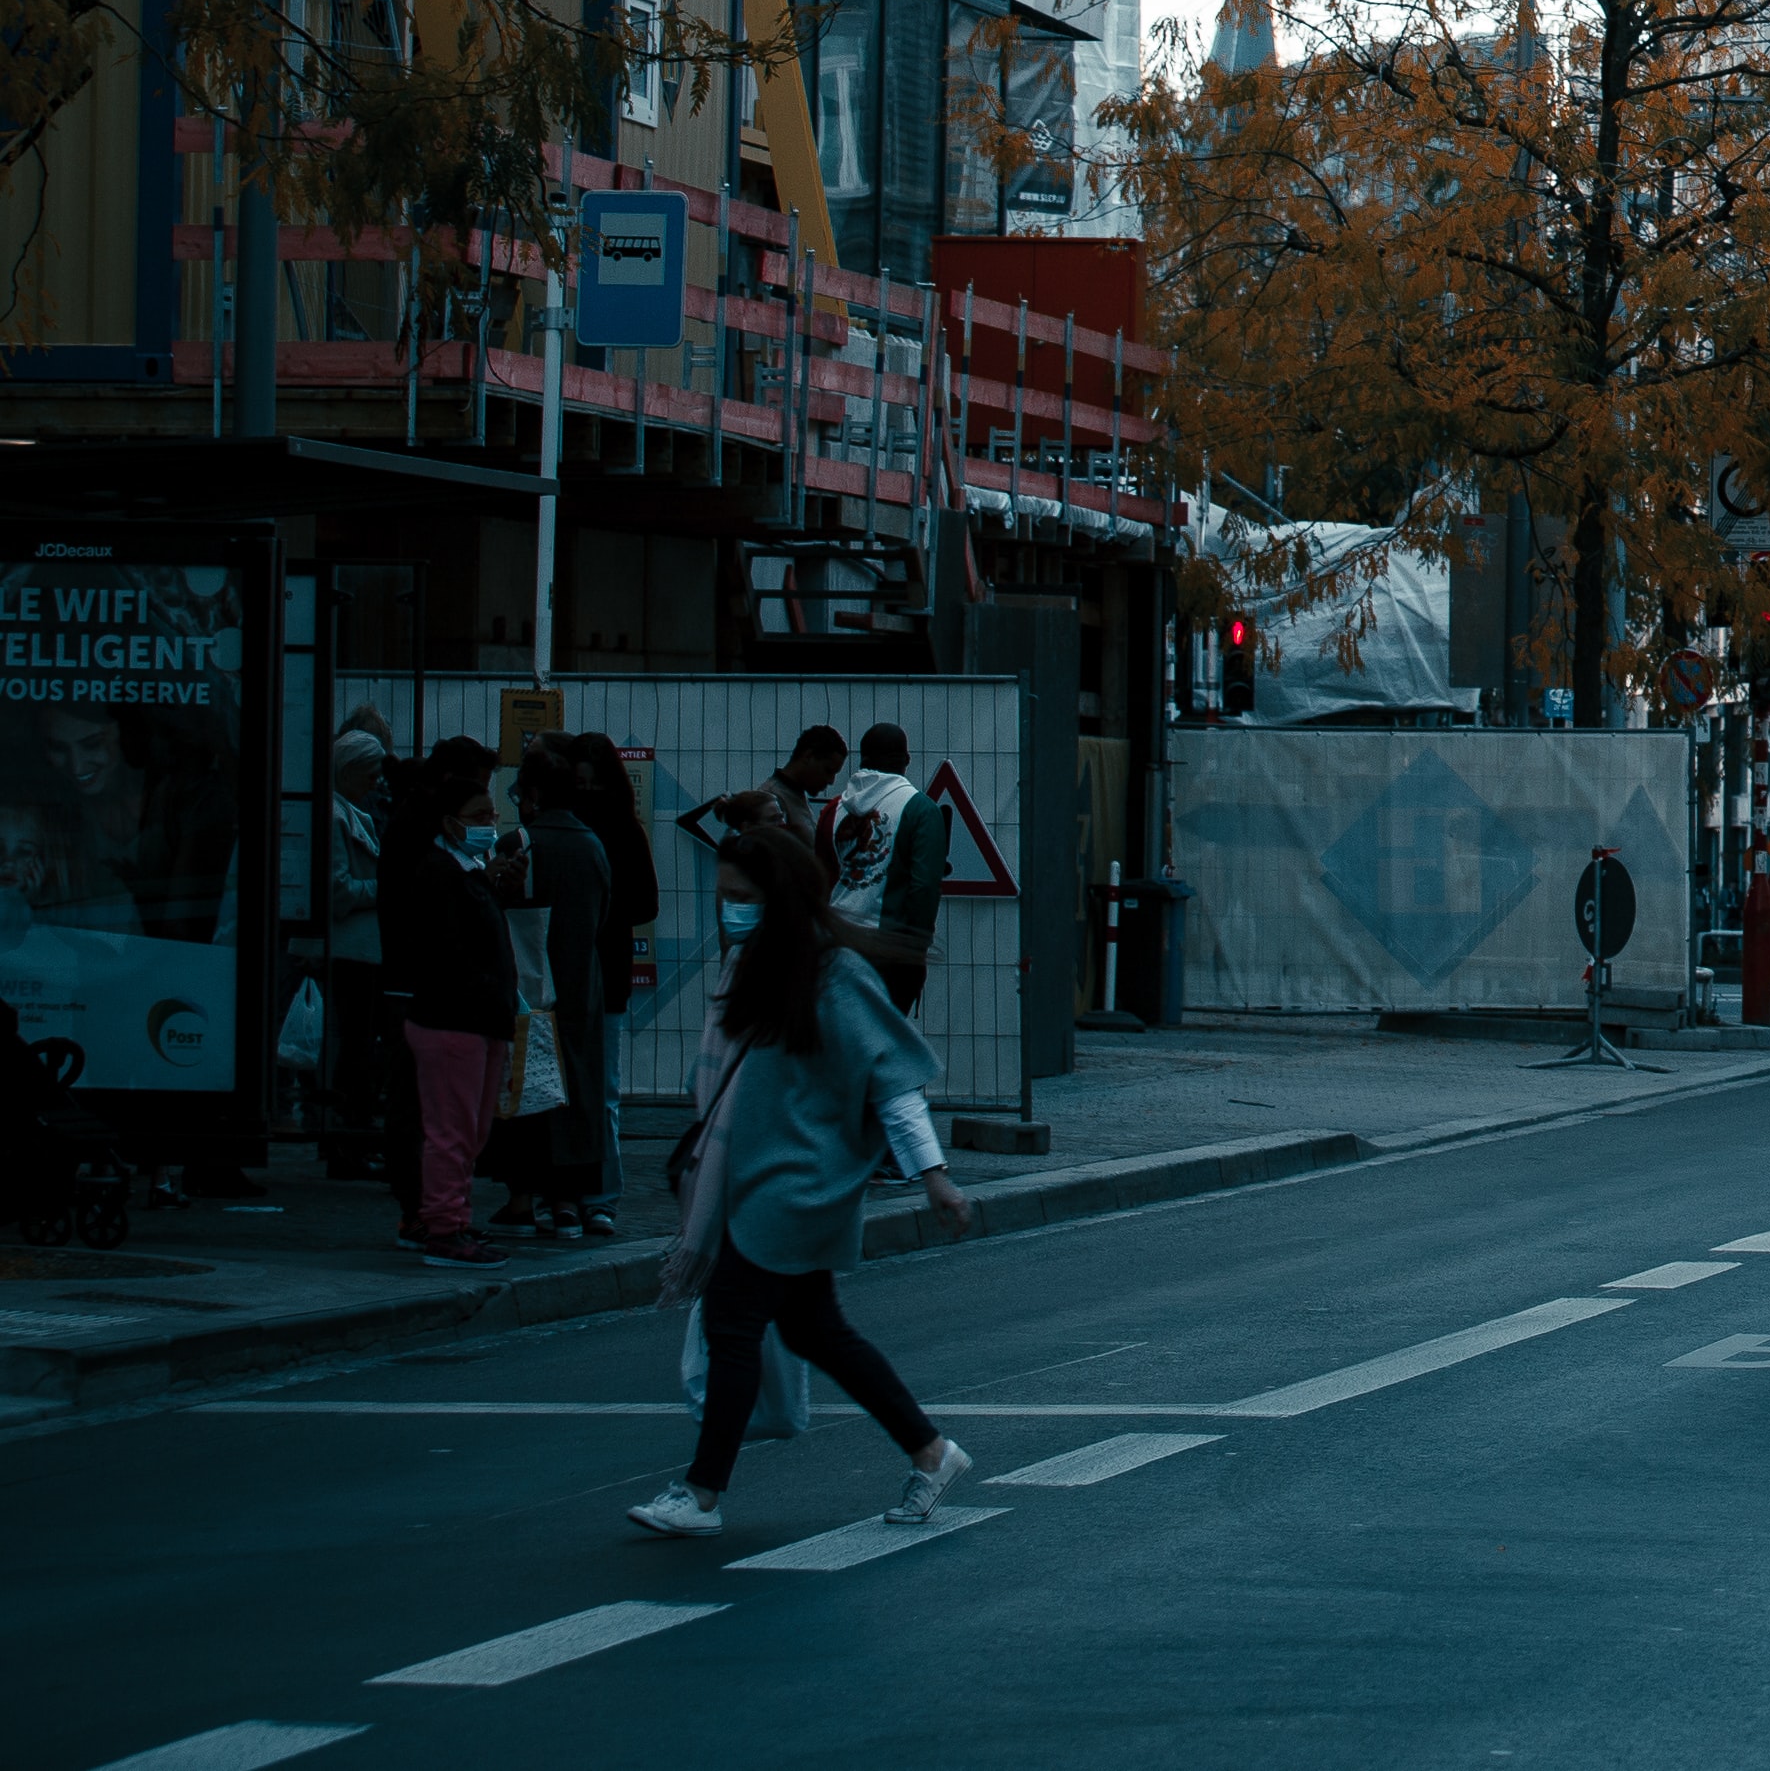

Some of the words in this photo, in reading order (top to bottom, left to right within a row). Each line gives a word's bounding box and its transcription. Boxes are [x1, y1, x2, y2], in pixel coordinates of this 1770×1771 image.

[34, 543, 113, 558] JCDecaux
[54, 588, 149, 624] WIFI
[0, 632, 217, 671] ELLIGENT
[72, 675, 212, 706] PRÉSERVE
